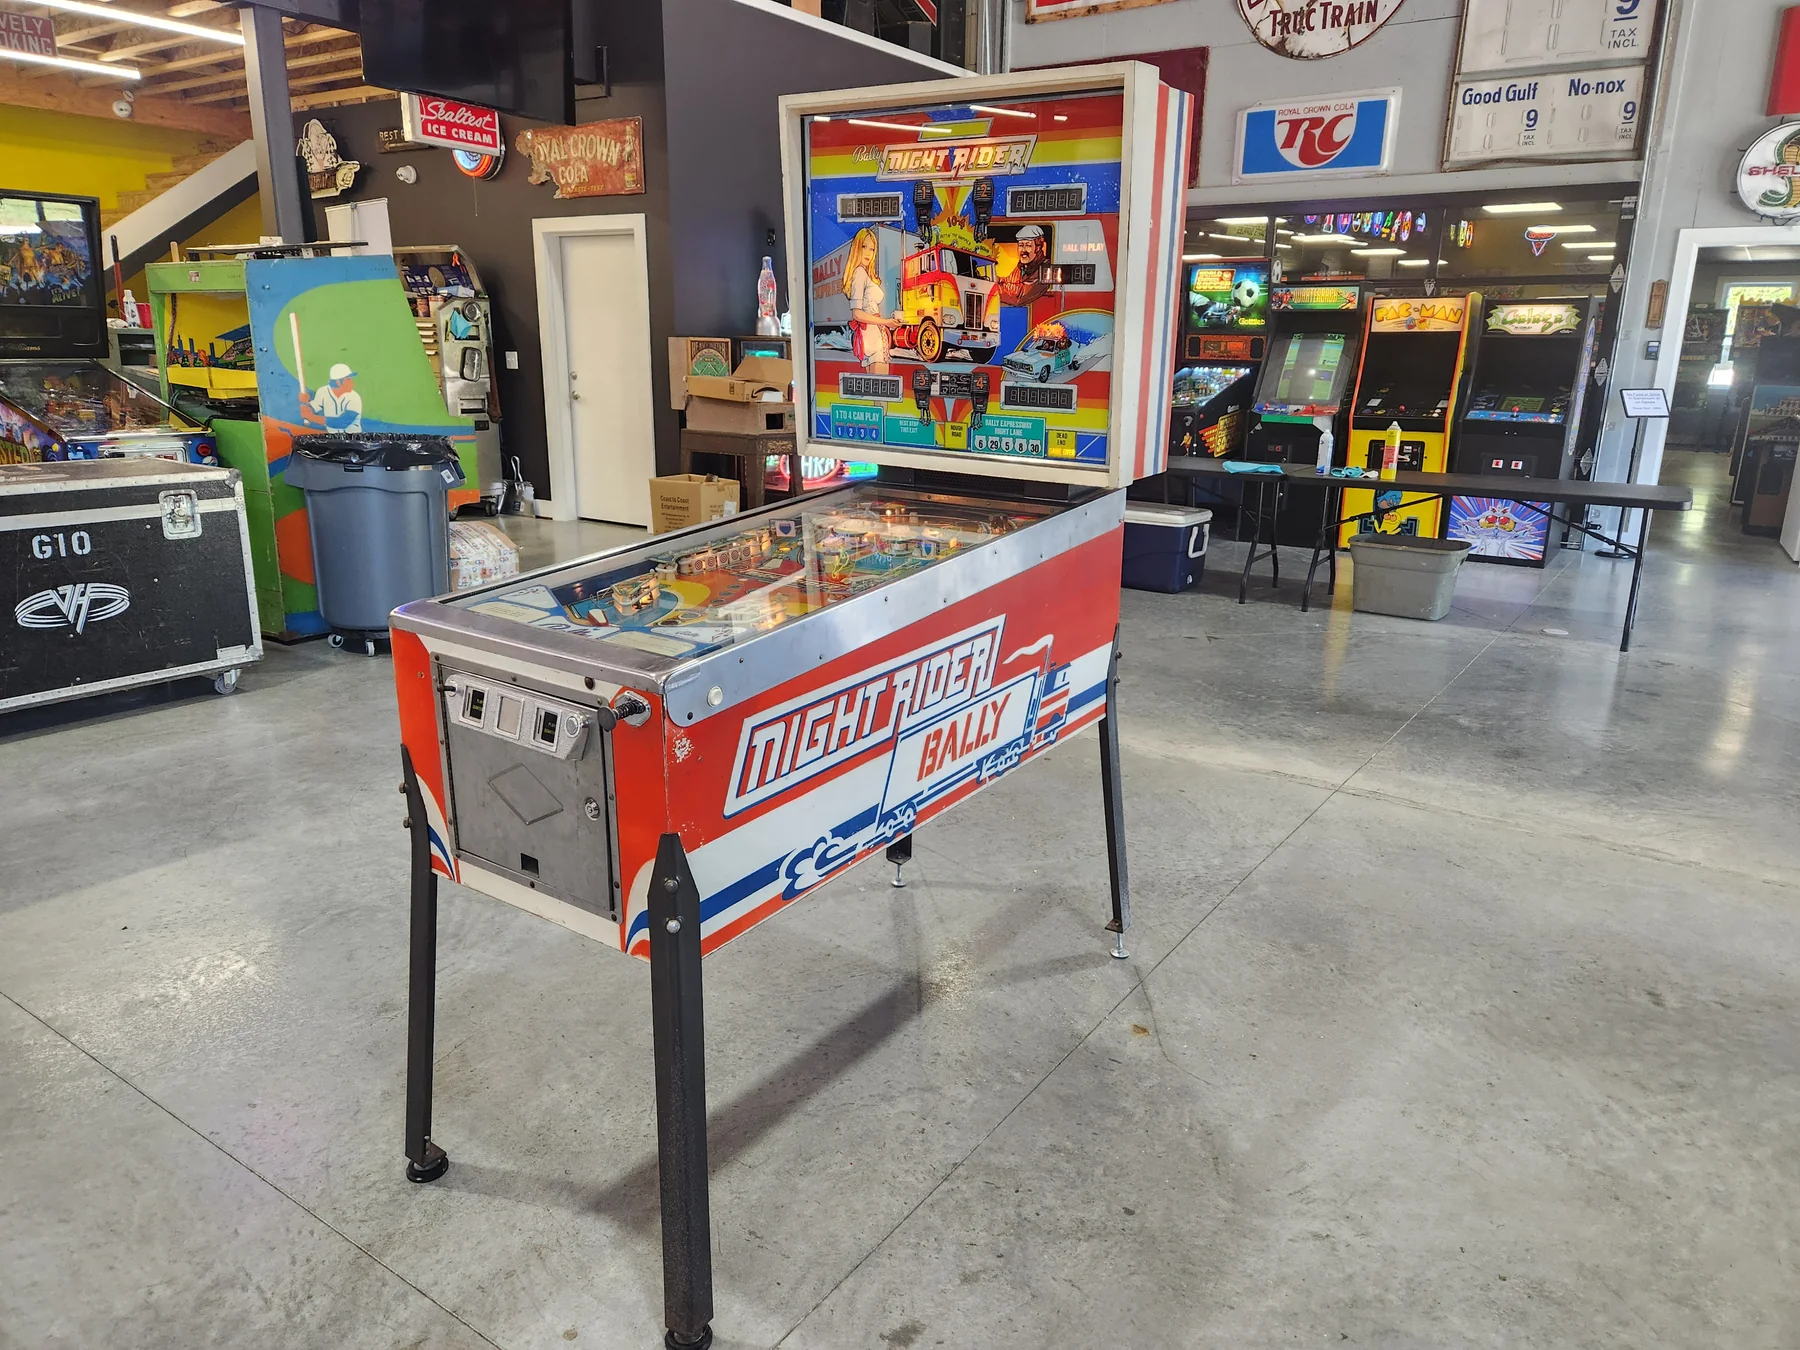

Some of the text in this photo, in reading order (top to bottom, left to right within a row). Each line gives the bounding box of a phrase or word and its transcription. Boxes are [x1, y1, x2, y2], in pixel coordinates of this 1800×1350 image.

[1320, 0, 1379, 29] TRAIN
[1611, 28, 1637, 38] TAX
[1462, 82, 1539, 106] Good Gulf
[426, 100, 494, 130] Sealtest
[1278, 102, 1354, 116] ROYAL CROWN COLA
[1525, 109, 1538, 128] 9
[1623, 101, 1636, 120] 9
[379, 129, 398, 141] REST
[427, 122, 493, 144] ICE CREAM
[1277, 113, 1354, 166] RC
[535, 133, 621, 167] OYAL CROWN
[852, 144, 1027, 176] Bally NIGHT RIDER
[558, 164, 589, 184] COLA
[921, 186, 927, 199] 1
[980, 184, 987, 197] 2
[1063, 244, 1078, 252] BALL
[1088, 243, 1105, 251] PLAY
[813, 254, 842, 284] BALLY
[1375, 302, 1463, 323] PAC-MAN
[1501, 308, 1565, 333] Galaga
[919, 374, 925, 386] 3
[976, 376, 984, 389] 4
[836, 411, 879, 422] 1 TO 4 CAN PLAY
[985, 419, 1033, 429] BALLY EXPRESSWAY
[838, 427, 876, 439] 1 2 3 4
[978, 439, 1039, 453] 6 29 5 8 30
[1062, 448, 1075, 456] OVER
[32, 531, 91, 559] G10
[736, 632, 996, 798] NIGHT RIDER
[916, 691, 1012, 783] BALLY
